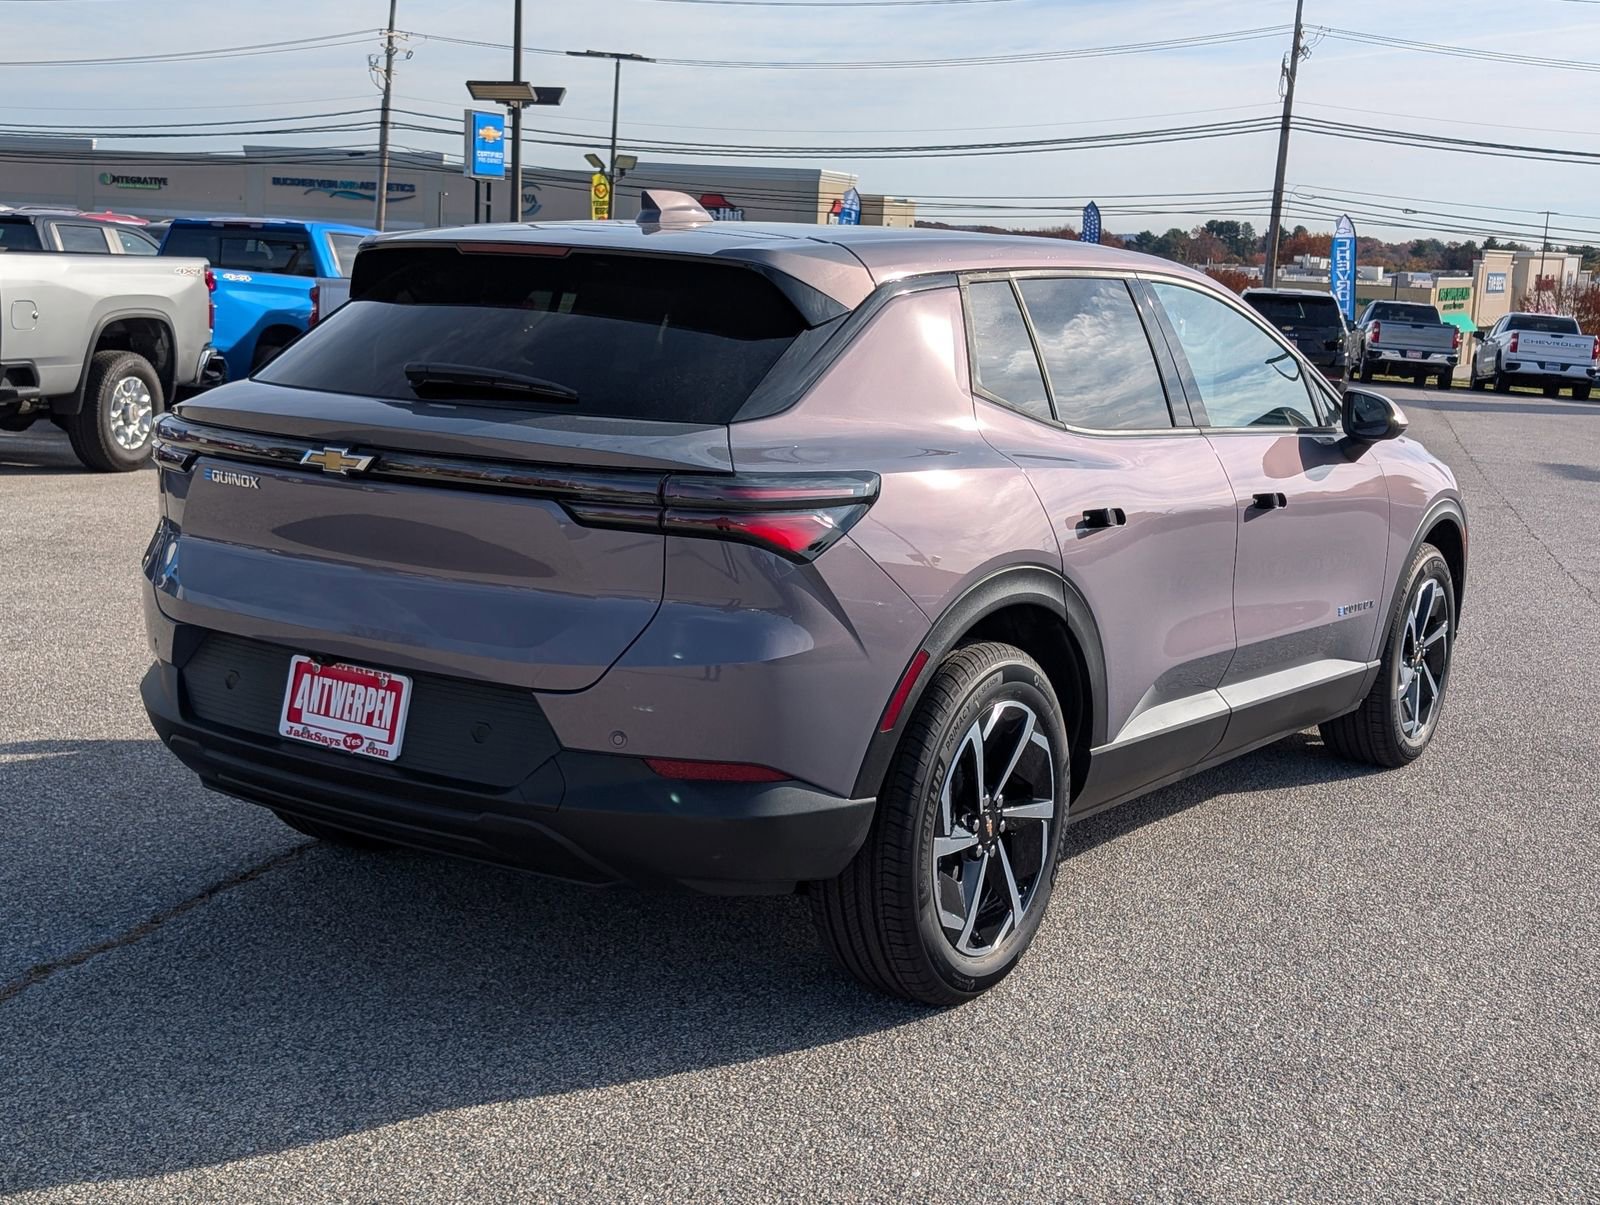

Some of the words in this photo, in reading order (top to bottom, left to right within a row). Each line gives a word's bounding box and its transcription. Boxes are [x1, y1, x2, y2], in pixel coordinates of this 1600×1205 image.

[1523, 338, 1589, 348] CHEVROLET
[204, 468, 260, 490] EQUINOX
[294, 673, 396, 730] ANTWERPEN
[945, 704, 972, 752] PRIMACY
[920, 765, 946, 872] MICHELIN
